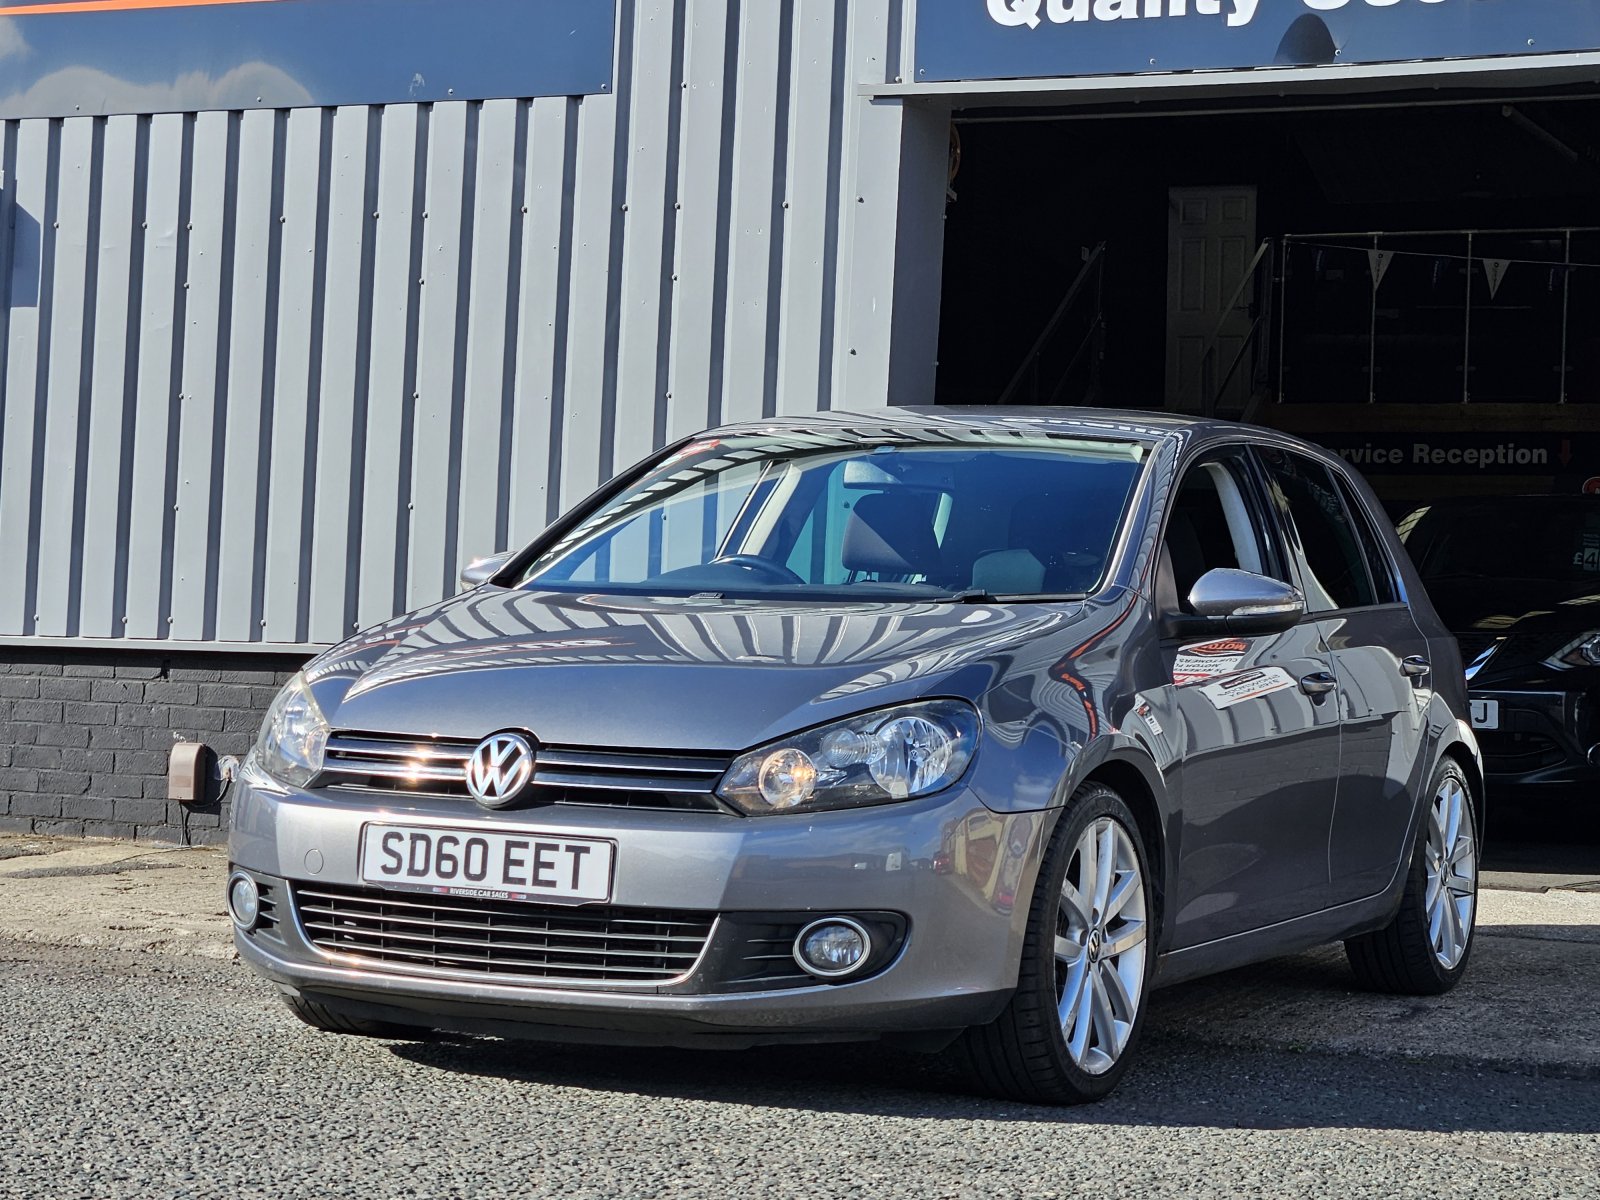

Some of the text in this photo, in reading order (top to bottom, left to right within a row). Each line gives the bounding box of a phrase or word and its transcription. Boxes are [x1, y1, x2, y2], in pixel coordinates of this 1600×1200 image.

[986, 0, 1260, 29] Quay
[1328, 443, 1549, 468] rvice Reception
[380, 831, 591, 890] SD60 EET
[449, 887, 508, 899] RIVERSIDE CAR SALES
